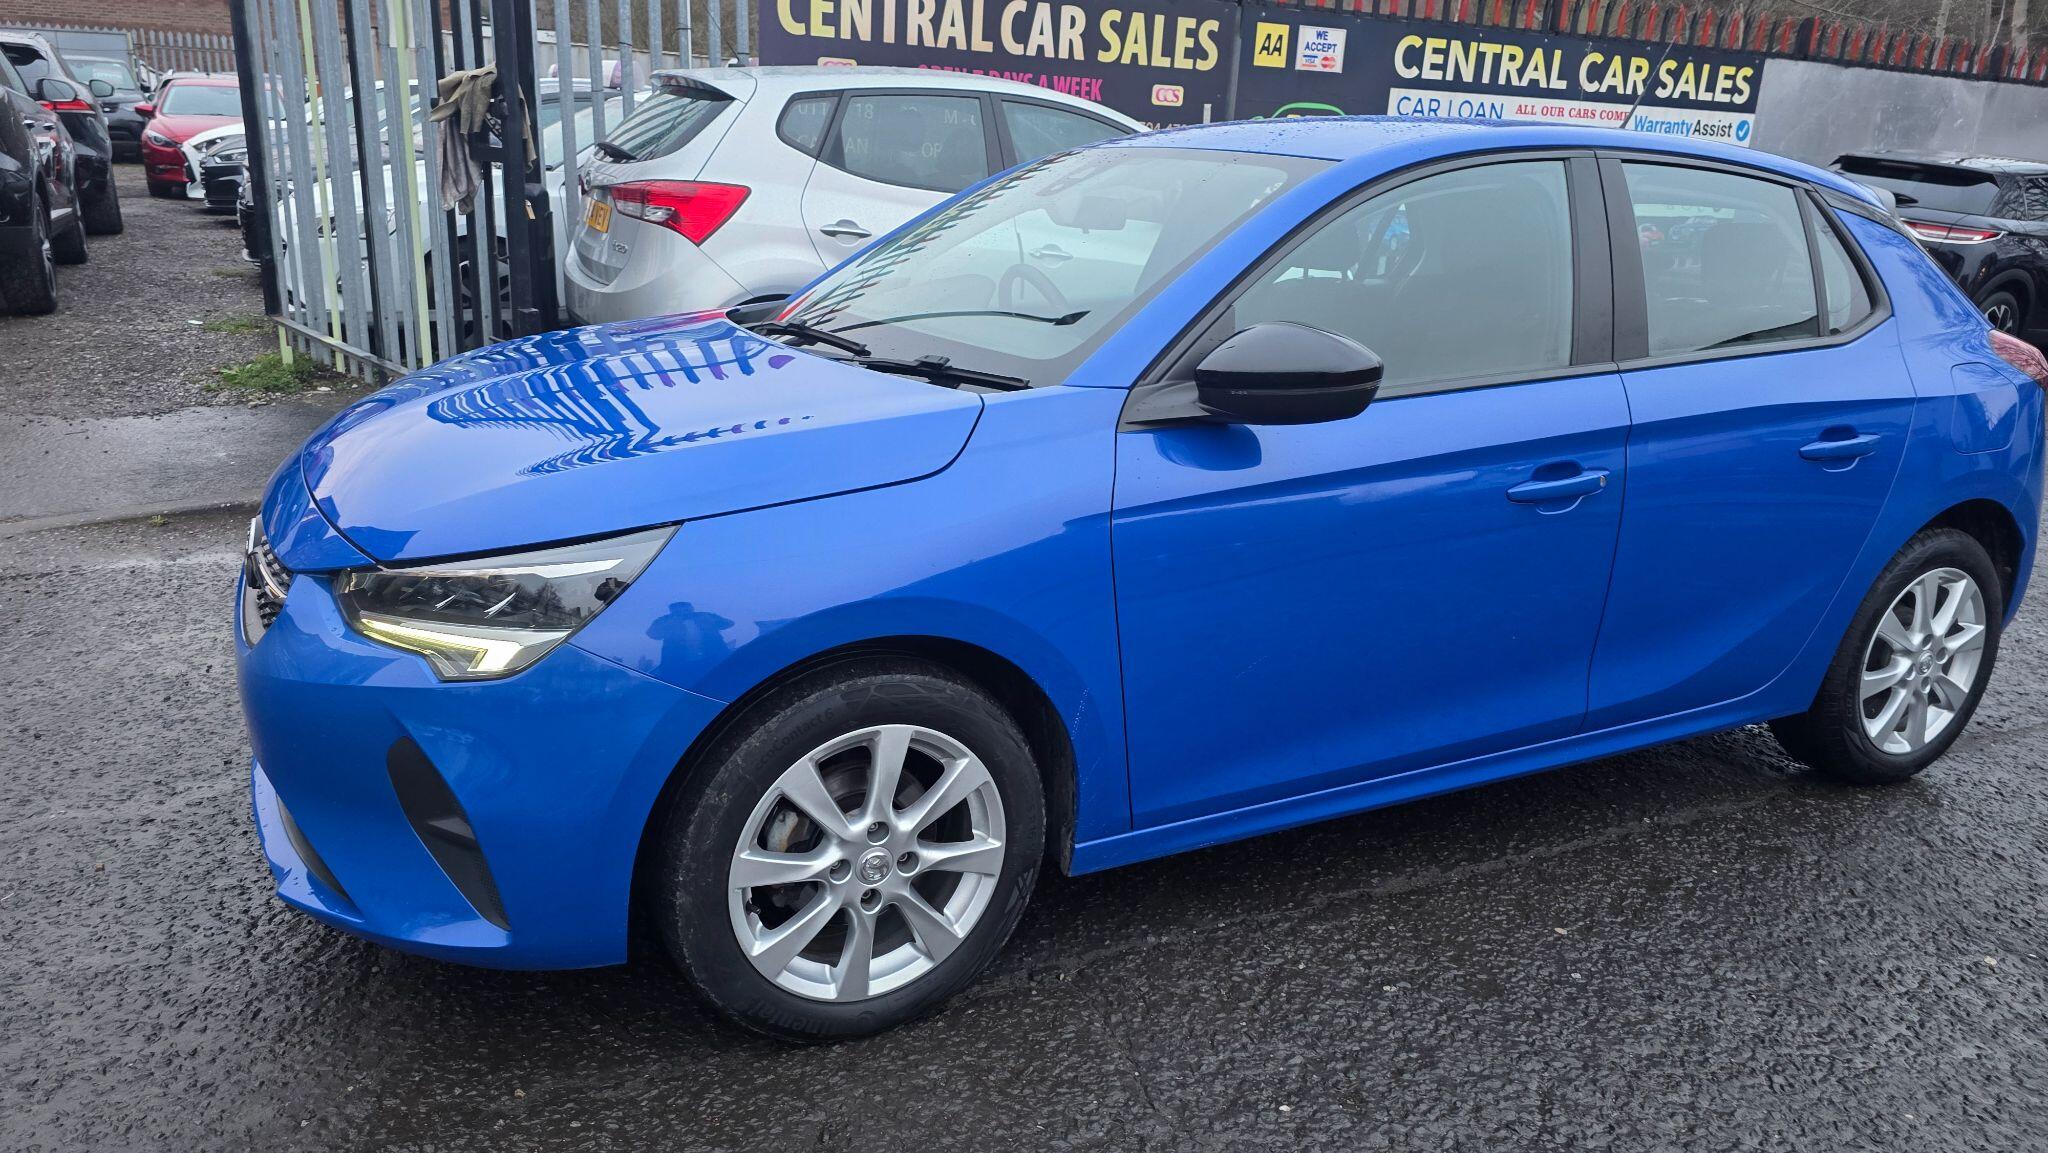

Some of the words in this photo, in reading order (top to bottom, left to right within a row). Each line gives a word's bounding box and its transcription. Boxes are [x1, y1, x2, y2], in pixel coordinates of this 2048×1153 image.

[777, 0, 994, 53] CENTRAL
[1000, 0, 1085, 61] CAR
[1097, 9, 1220, 71] SALES
[1258, 33, 1284, 56] AA
[1316, 30, 1329, 40] WE
[1304, 42, 1338, 53] ACCEPT
[1394, 34, 1568, 90] CENTRAL
[1579, 52, 1650, 96] CAR
[1654, 59, 1754, 105] SALES
[1053, 76, 1103, 101] WEEK
[1397, 96, 1440, 117] CAR
[1515, 104, 1537, 116] ALL
[1541, 105, 1565, 117] OUR
[1568, 107, 1597, 119] CARS
